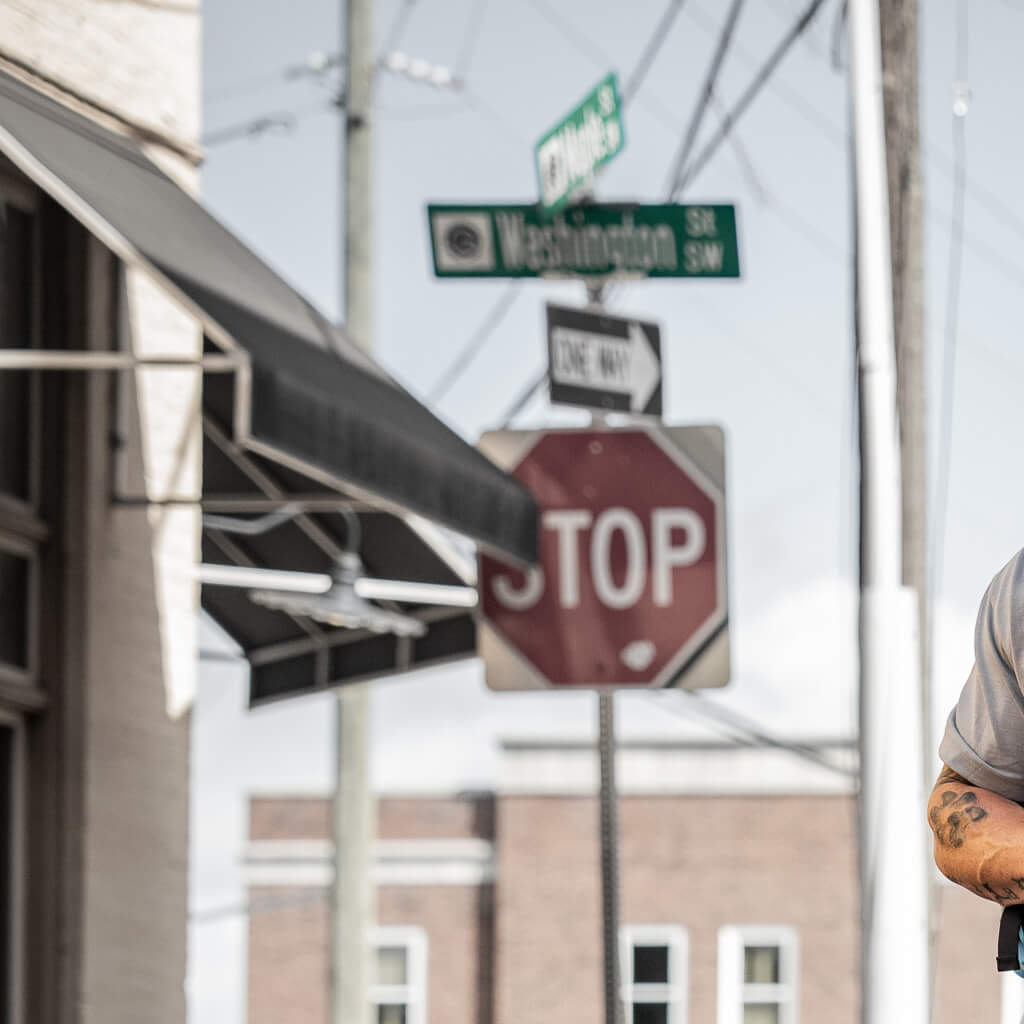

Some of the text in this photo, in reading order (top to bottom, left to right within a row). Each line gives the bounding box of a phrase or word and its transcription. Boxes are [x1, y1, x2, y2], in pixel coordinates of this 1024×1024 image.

[496, 209, 678, 272] Washington
[683, 240, 725, 273] SW
[553, 338, 630, 385] ONE WAY
